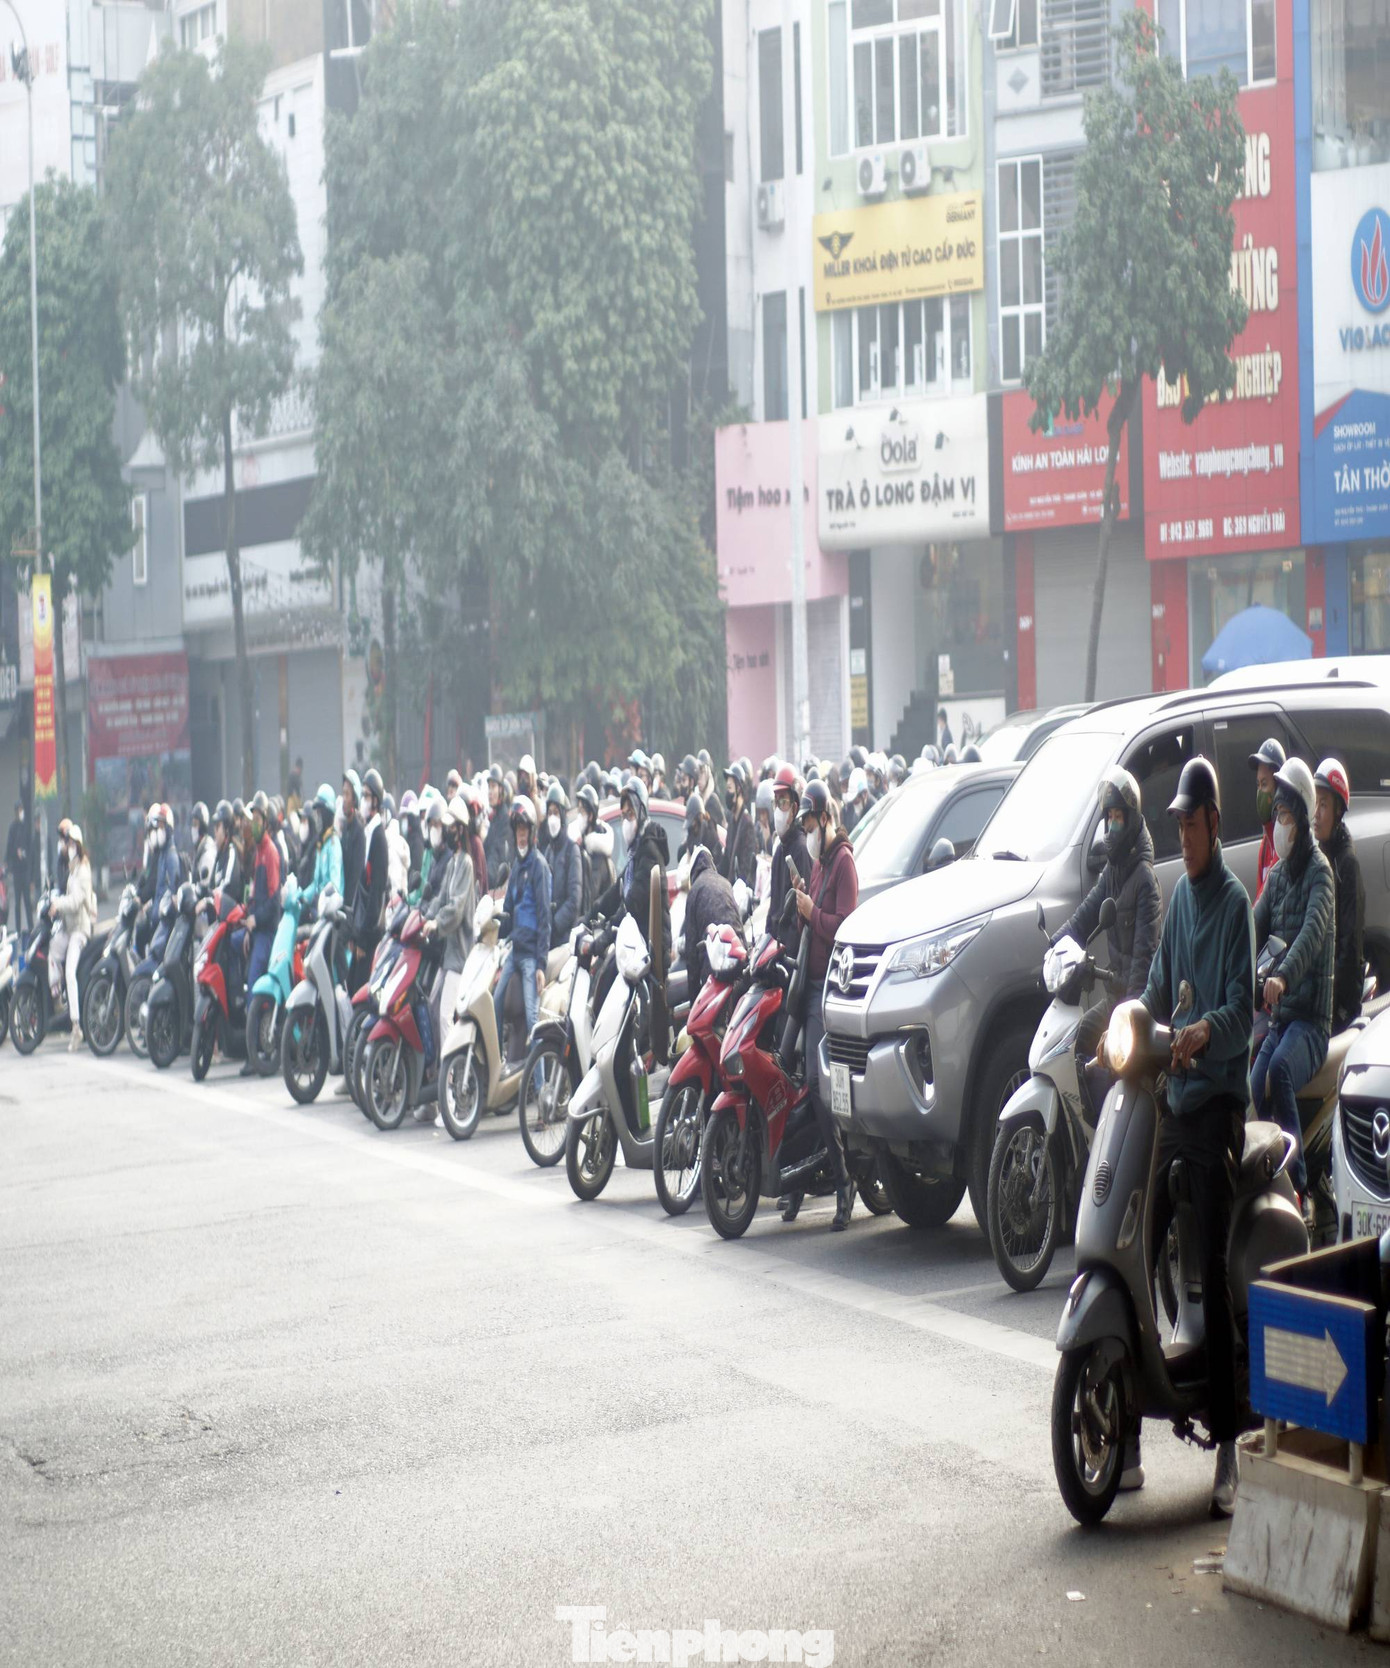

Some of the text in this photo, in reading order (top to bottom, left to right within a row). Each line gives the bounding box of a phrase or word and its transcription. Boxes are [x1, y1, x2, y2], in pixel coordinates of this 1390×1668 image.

[913, 248, 932, 266] CAO
[1333, 421, 1376, 439] SHOWROOM
[1012, 450, 1034, 473] KÍNH
[1035, 452, 1049, 470] AN
[1050, 446, 1075, 468] TOÀN
[826, 472, 976, 512] TRÀ Ô LONG ĐẬM VỊ
[1334, 464, 1360, 494] TÂN
[726, 486, 755, 515] Tiệm
